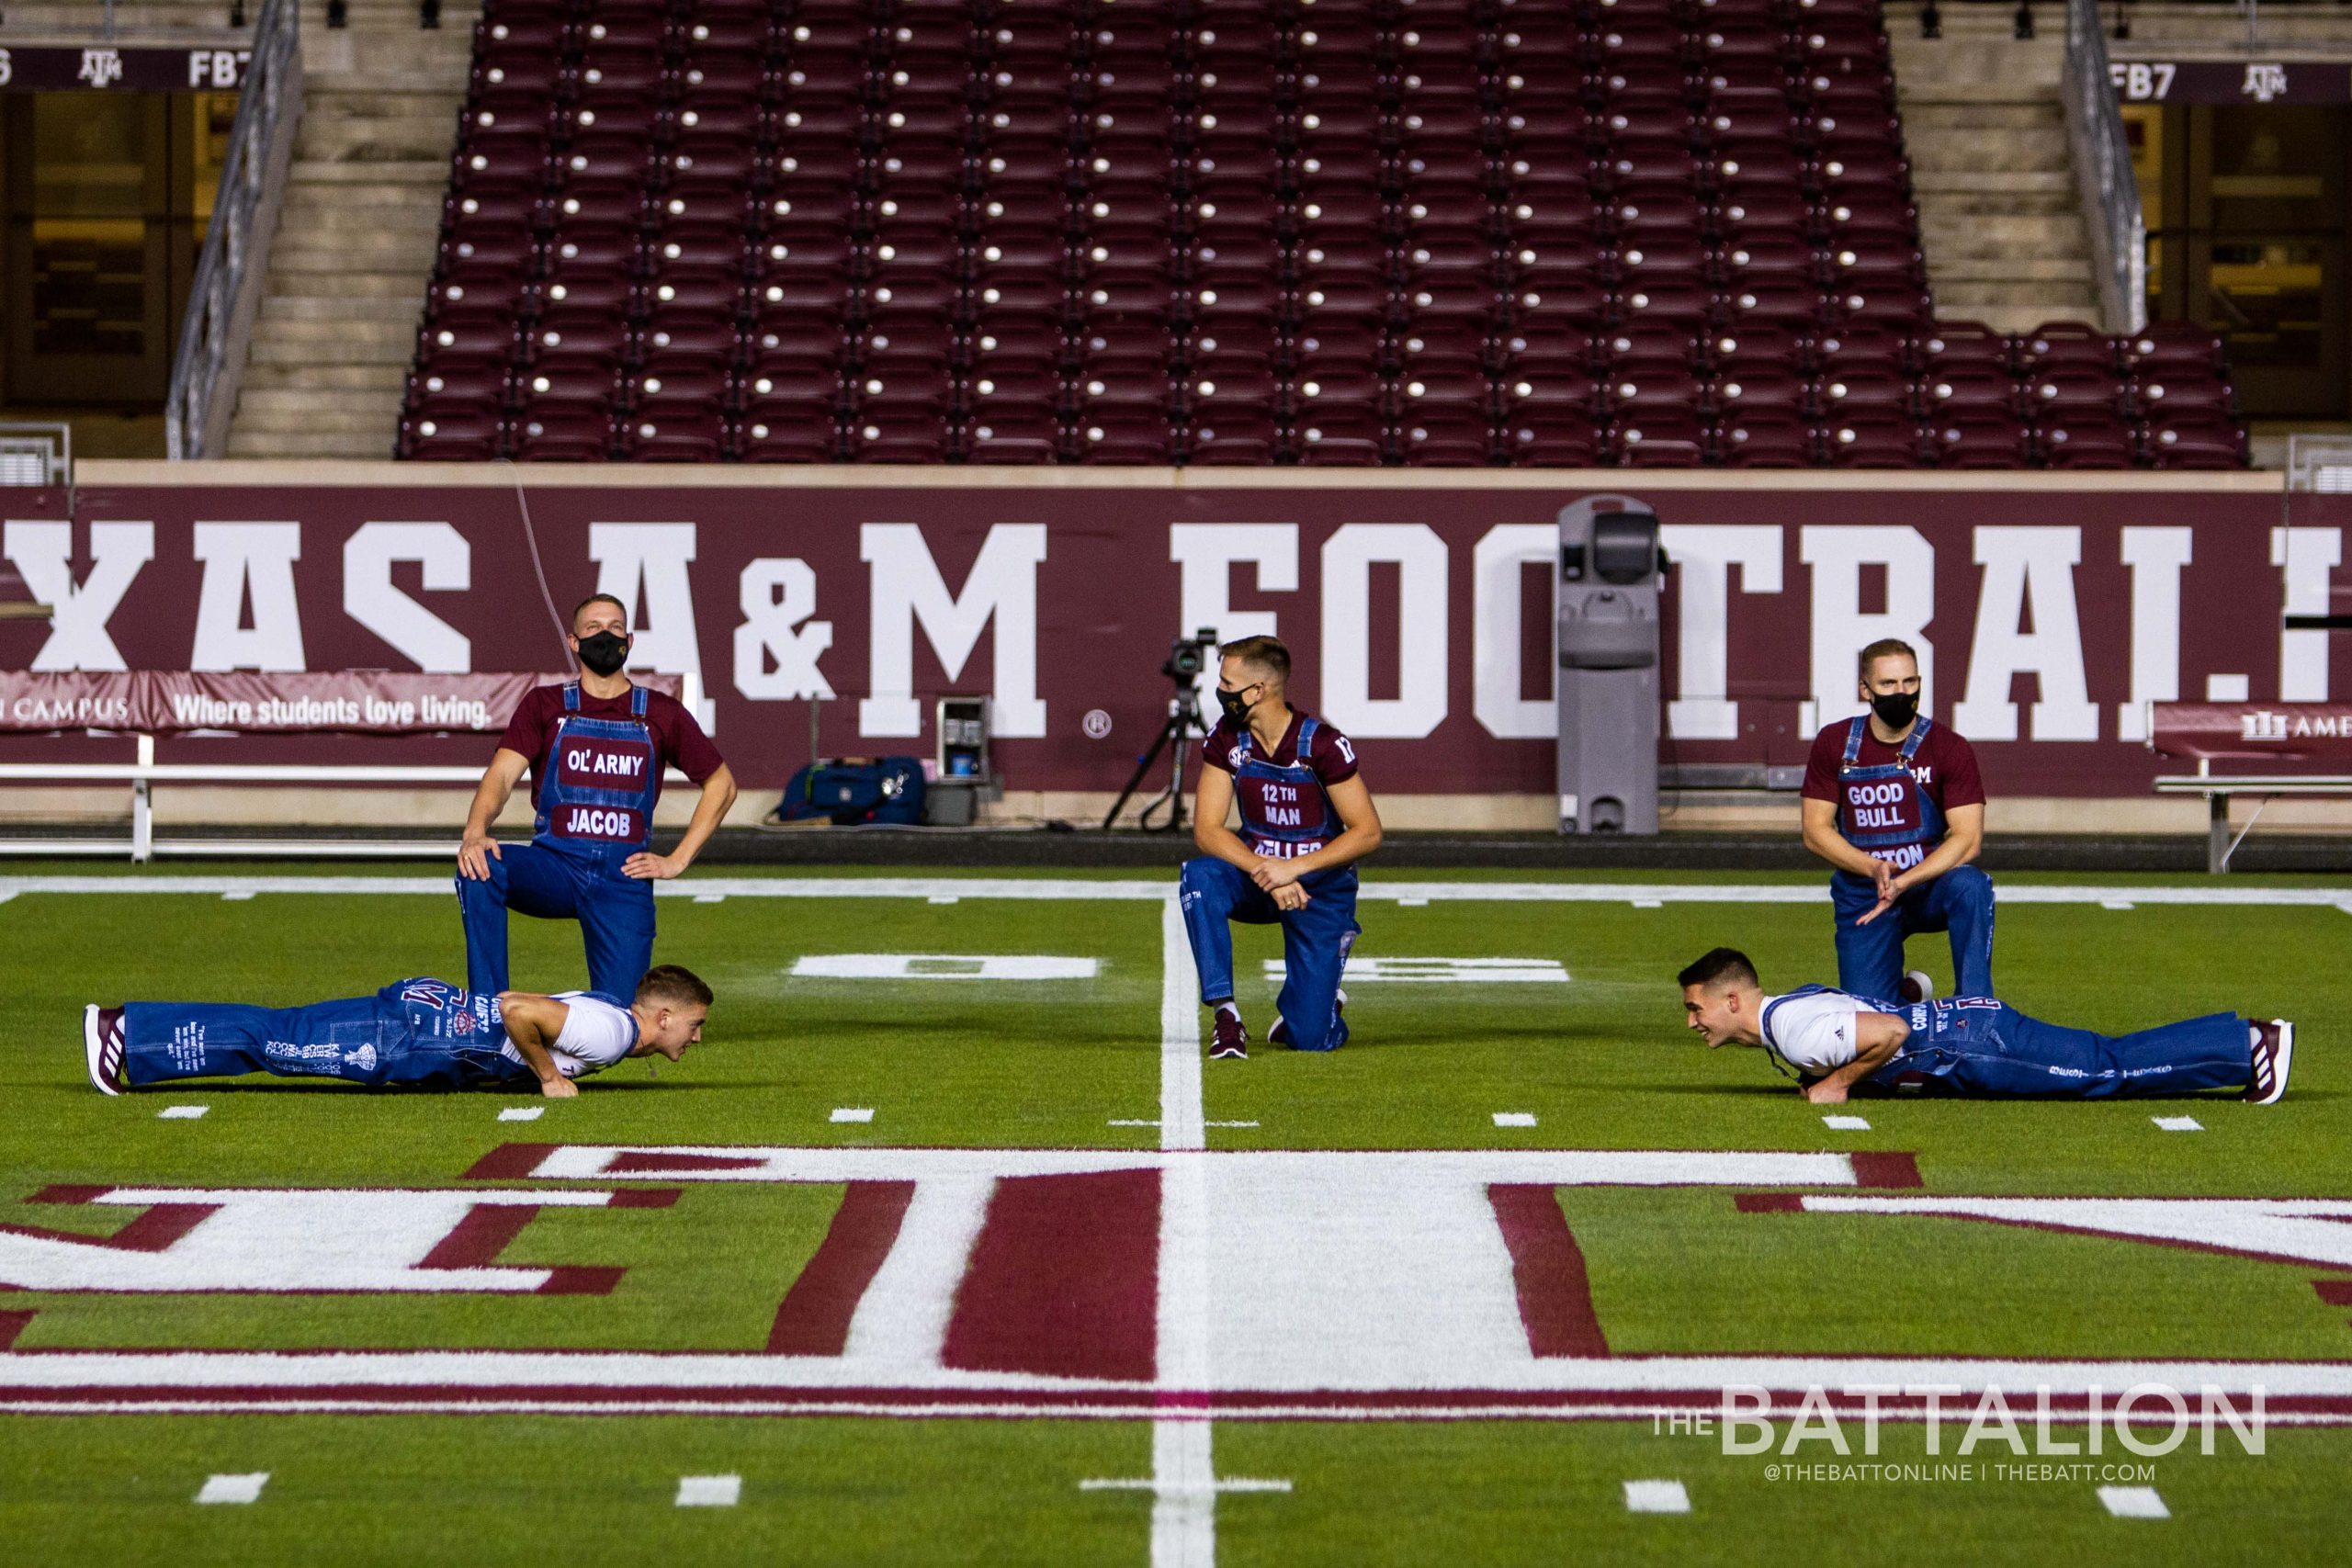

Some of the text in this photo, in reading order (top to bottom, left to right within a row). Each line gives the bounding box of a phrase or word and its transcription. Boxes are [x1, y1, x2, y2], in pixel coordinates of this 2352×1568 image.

[588, 522, 1046, 739] A&M
[14, 697, 128, 721] CAMPUS
[174, 694, 492, 730] Where students love living.
[567, 749, 643, 776] OL' ARMY
[1848, 783, 1904, 806] GOOD
[567, 808, 630, 837] JACOB
[1265, 806, 1300, 825] MAN
[1855, 807, 1905, 827] BULL
